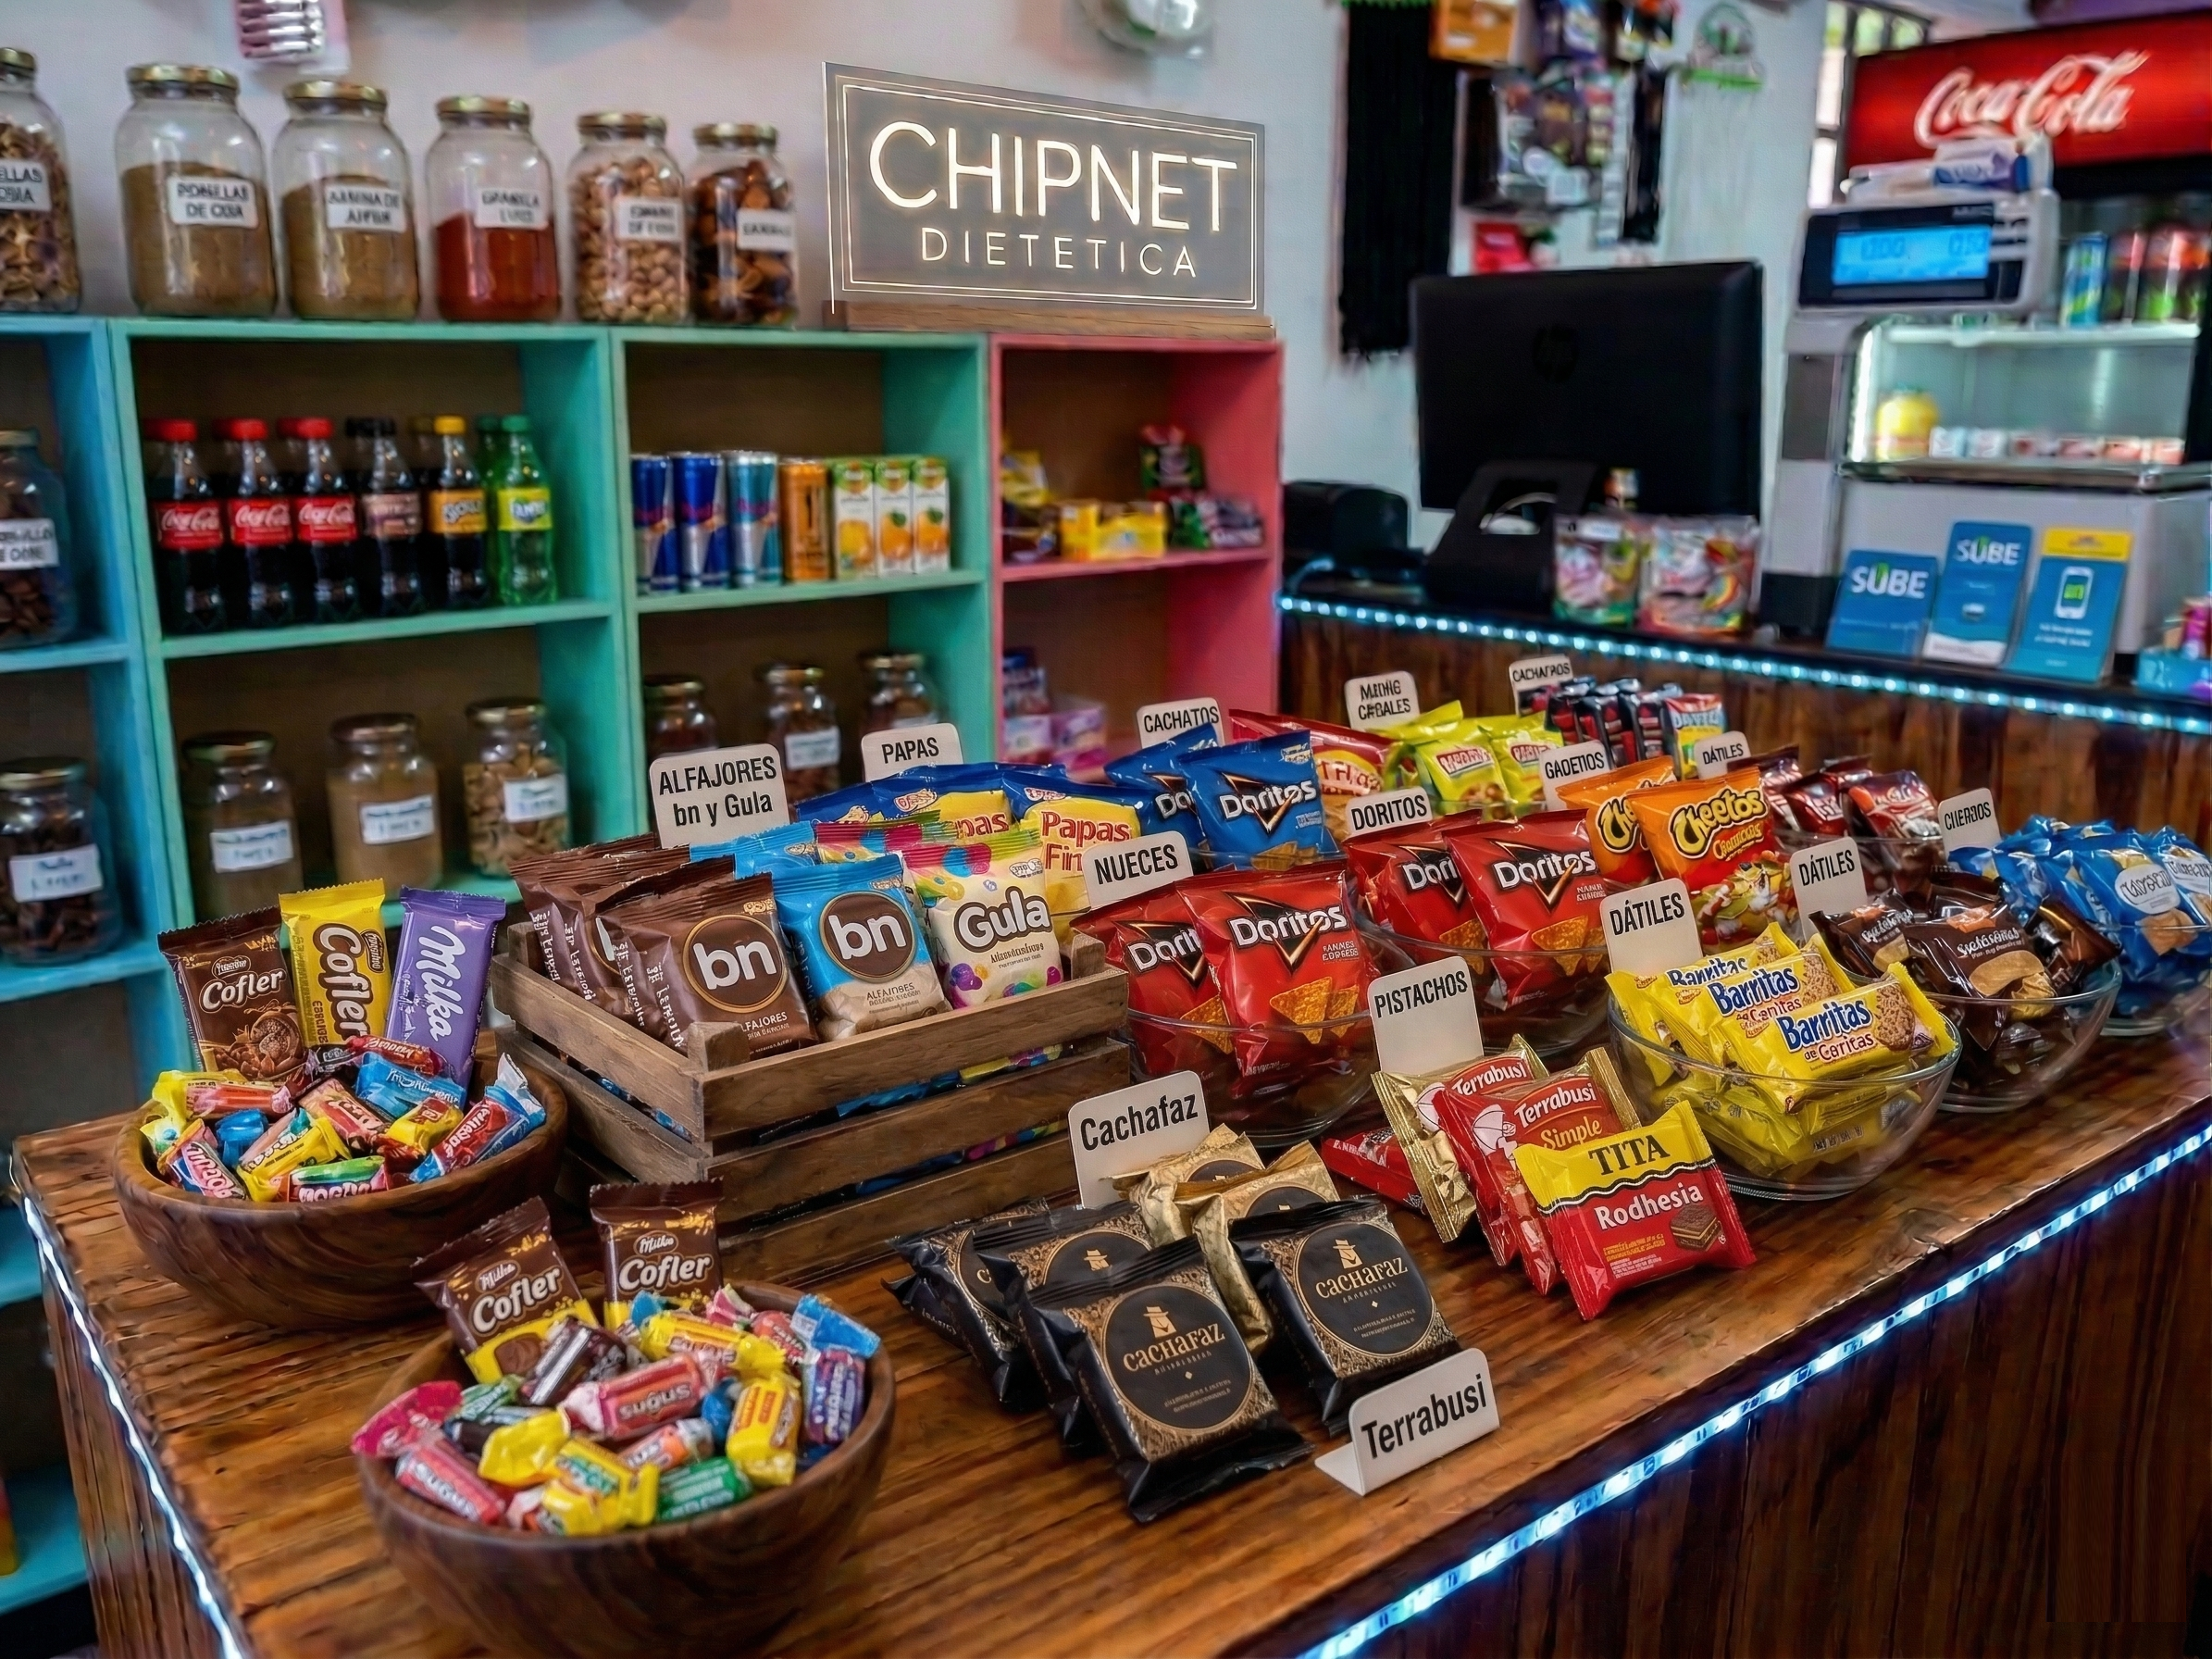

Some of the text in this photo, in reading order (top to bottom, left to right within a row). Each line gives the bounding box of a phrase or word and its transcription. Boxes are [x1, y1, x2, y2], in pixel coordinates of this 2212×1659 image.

[869, 121, 1237, 231] CHIPNET
[921, 227, 1197, 278] DIETETICA
[1955, 536, 2022, 566] SUBE
[1851, 562, 1930, 600] SUBE
[881, 737, 939, 765] PAPAS
[658, 755, 777, 796] ALFAJORES
[673, 791, 773, 827] bn y Gula
[1219, 780, 1317, 820] Doritos
[1350, 794, 1428, 830] DORITOS
[955, 812, 1011, 840] pas
[1040, 811, 1131, 848] Papas
[1670, 787, 1767, 856] Cheetos
[1044, 842, 1083, 871] Fin
[1094, 843, 1179, 885] NUECES
[1402, 855, 1458, 890] Dori
[1493, 851, 1597, 889] Doritos
[1797, 846, 1856, 887] DÁTILES
[956, 889, 1051, 950] Gula
[1229, 905, 1348, 946] Doritos
[1609, 892, 1686, 936] DÁTILES
[828, 914, 907, 960] bn
[1127, 928, 1202, 970] Dorit
[317, 926, 370, 1041] Cofler
[417, 925, 466, 1042] Milka
[693, 940, 777, 991] bn
[203, 969, 283, 1011] Cofler
[1373, 970, 1468, 1018] PISTACHOS
[1708, 967, 1800, 1016] Barritas
[740, 1012, 788, 1033] LFAJORES
[1775, 999, 1873, 1054] Barritas
[1079, 1092, 1199, 1152] Cachafaz
[1514, 1082, 1597, 1129] Terrabusi
[1540, 1116, 1603, 1151] Simple
[1589, 1134, 1671, 1176] TITA
[1594, 1181, 1704, 1230] Rodhesia
[617, 1255, 712, 1291] Cofler
[472, 1266, 561, 1334] Cofler
[1361, 1374, 1489, 1461] Terrabusi
